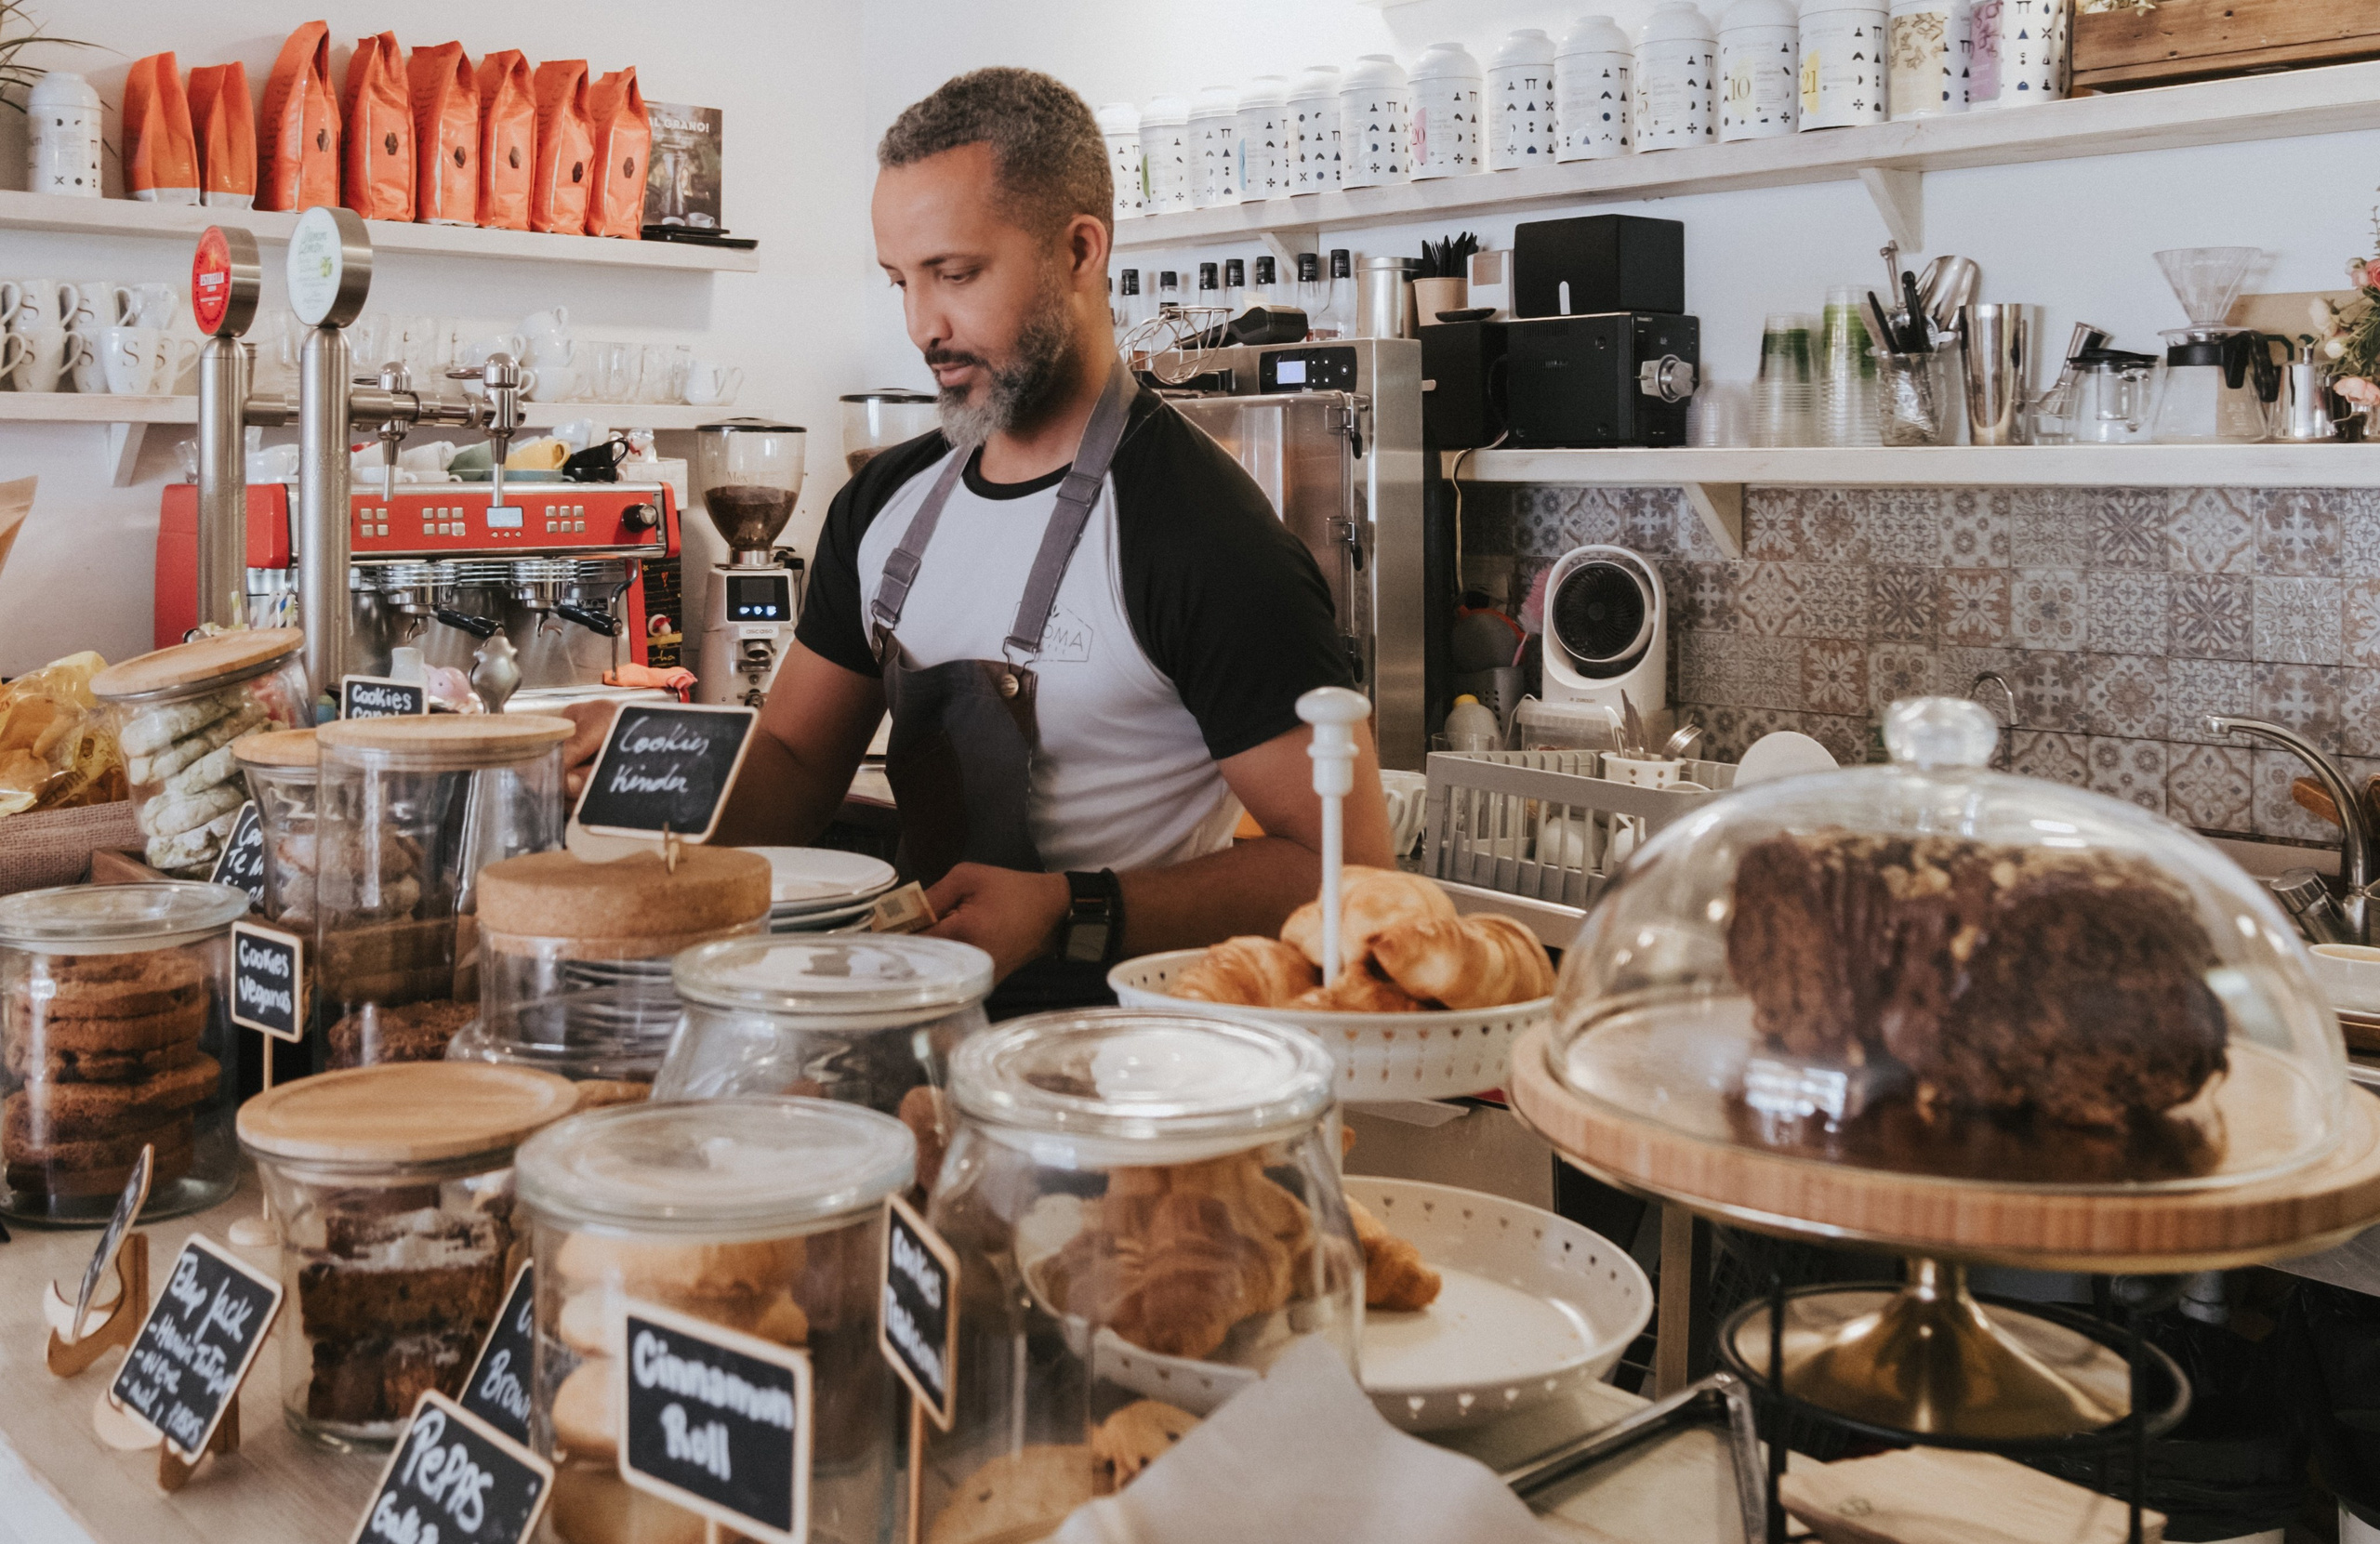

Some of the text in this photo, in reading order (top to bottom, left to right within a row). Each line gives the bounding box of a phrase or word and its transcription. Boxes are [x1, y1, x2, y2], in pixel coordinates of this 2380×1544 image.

[1731, 76, 1751, 100] 10
[1802, 70, 1818, 94] 21
[664, 118, 710, 133] GRANO!
[1411, 126, 1426, 146] 20
[20, 294, 39, 321] S
[78, 297, 95, 323] S
[78, 340, 94, 367] S
[123, 340, 139, 368] S
[352, 684, 412, 711] Cookies
[619, 715, 709, 756] Cookies
[610, 763, 689, 793] Kinder
[239, 939, 289, 978] Cookies
[480, 1349, 533, 1430] Brow
[633, 1329, 794, 1431] Cinnamon
[660, 1402, 732, 1482] Roll
